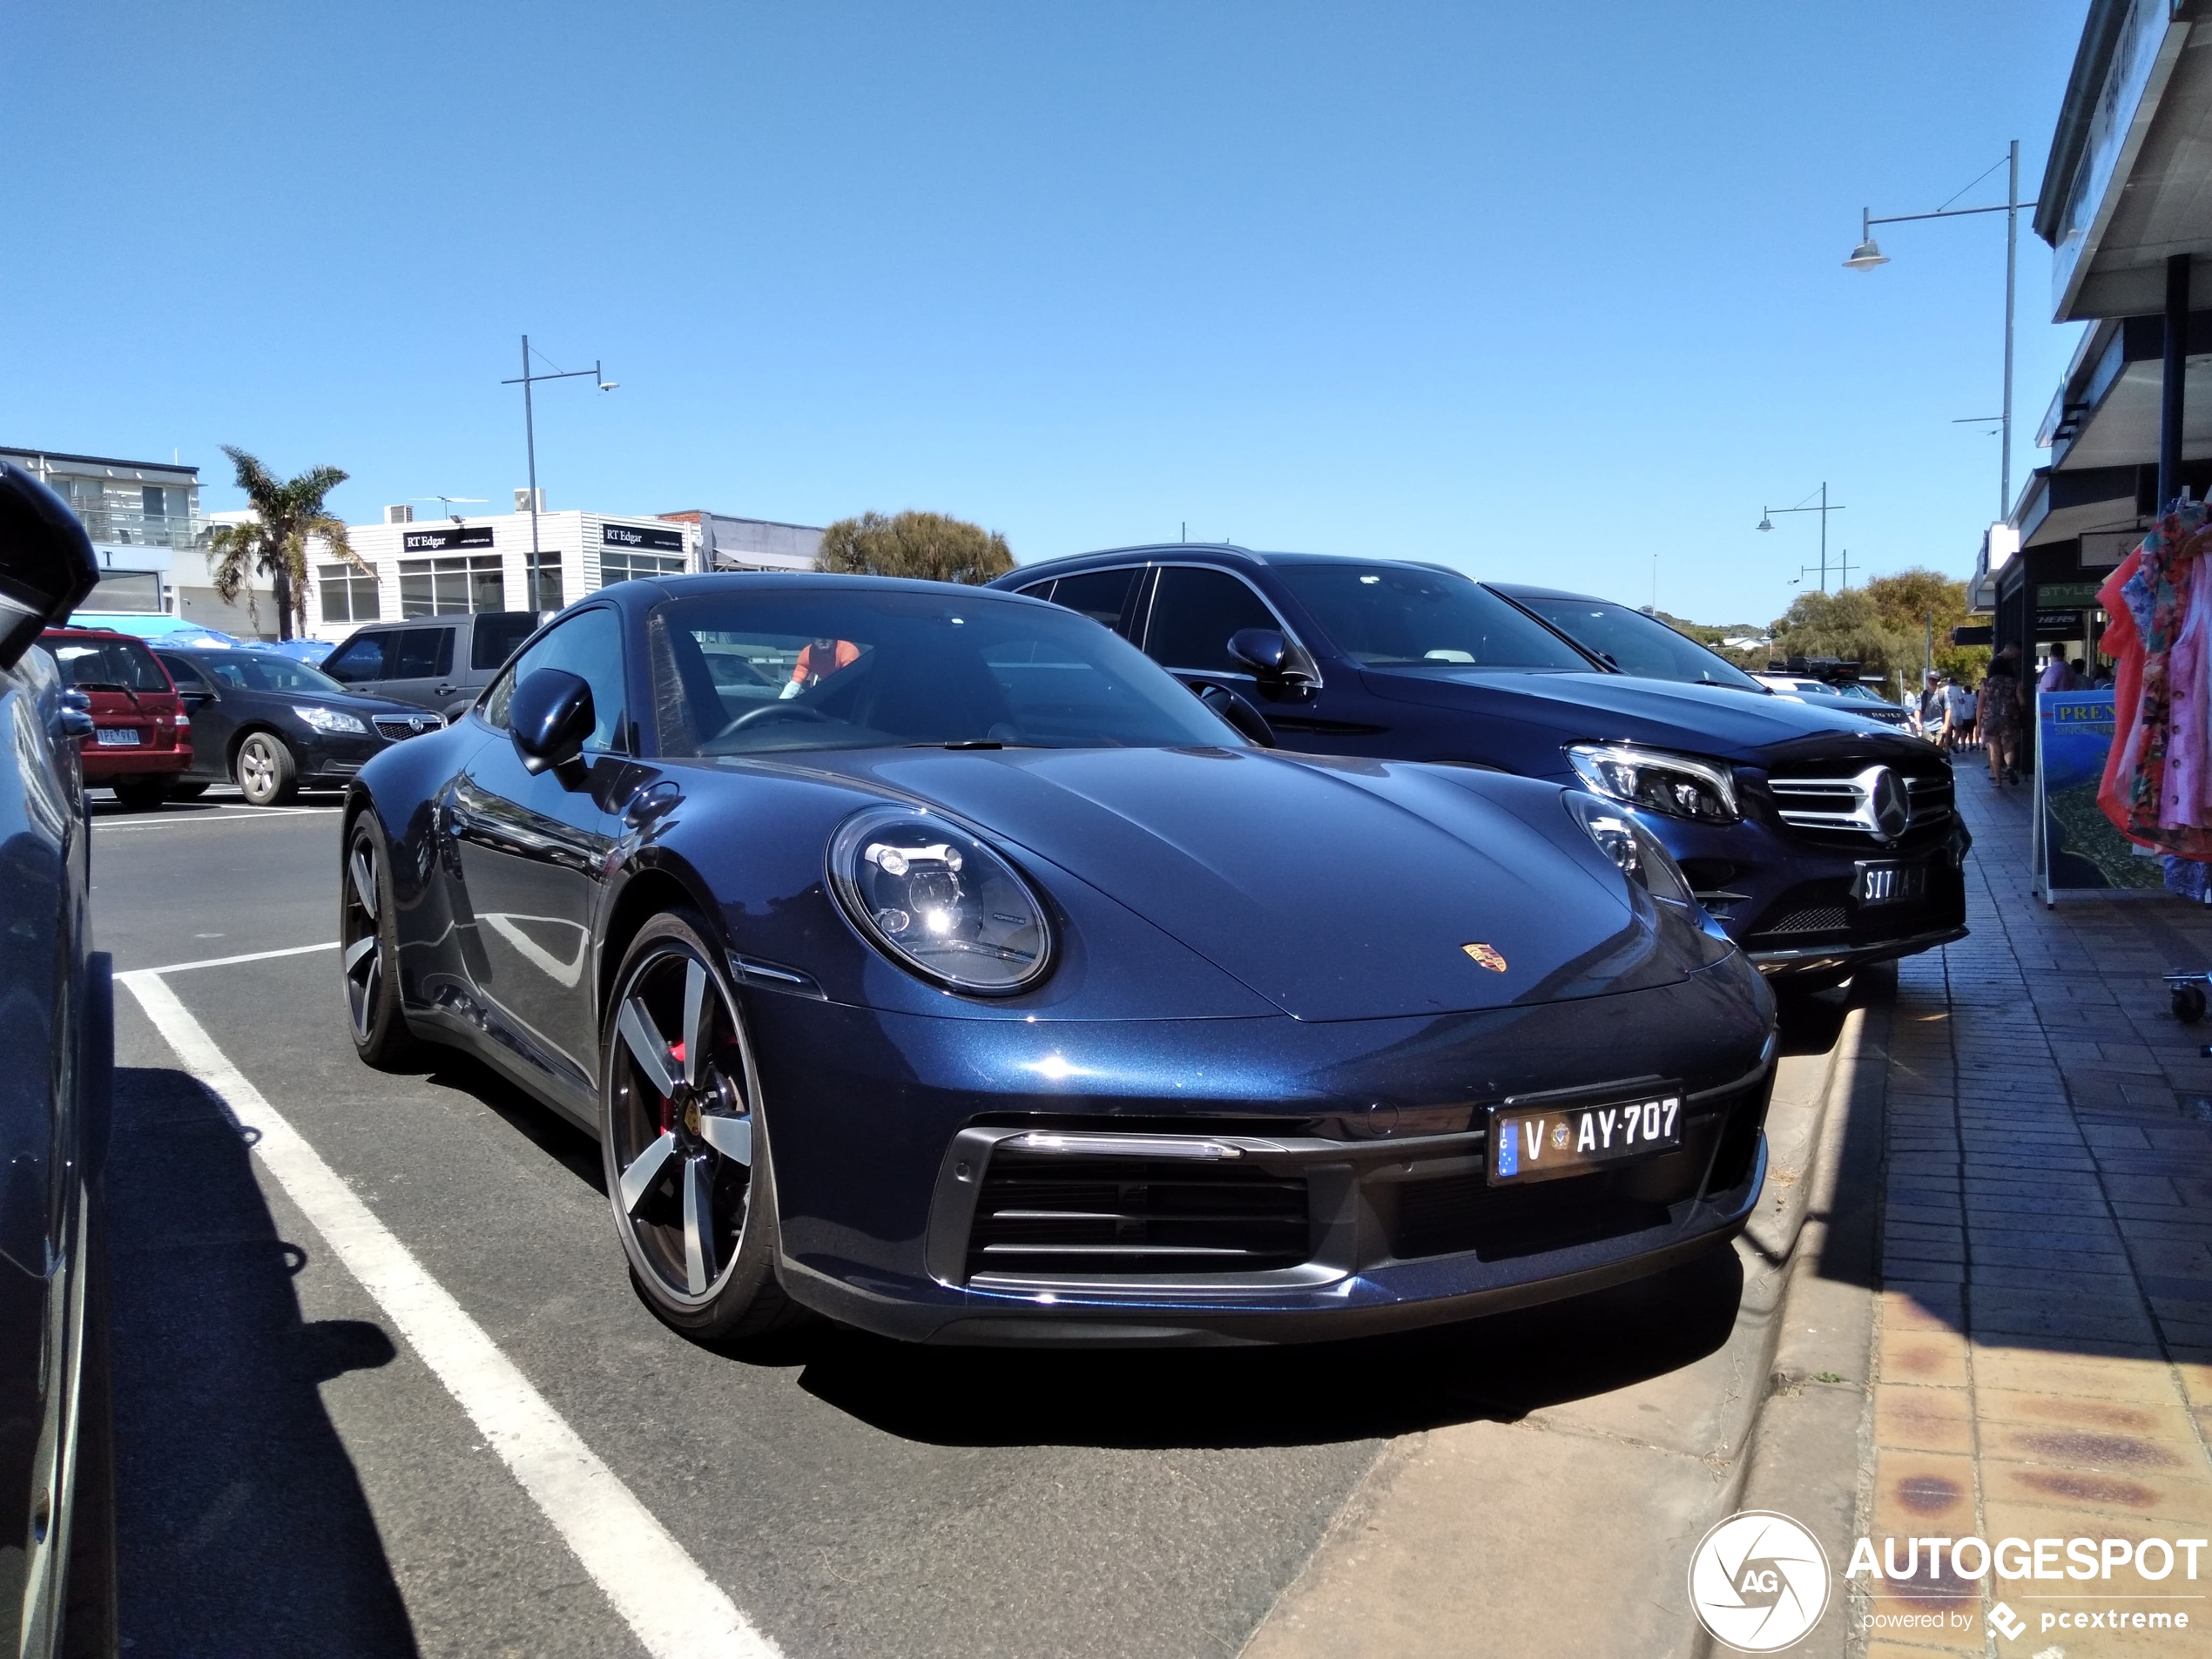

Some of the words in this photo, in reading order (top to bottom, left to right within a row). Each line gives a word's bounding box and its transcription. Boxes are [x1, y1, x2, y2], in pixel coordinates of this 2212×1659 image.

[407, 536, 420, 547] RT
[421, 536, 446, 548] Edgar
[607, 529, 618, 540] RT
[620, 531, 642, 544] Edgar
[103, 551, 113, 566] T
[2055, 725, 2089, 735] SINCE
[1525, 1120, 1545, 1160] V
